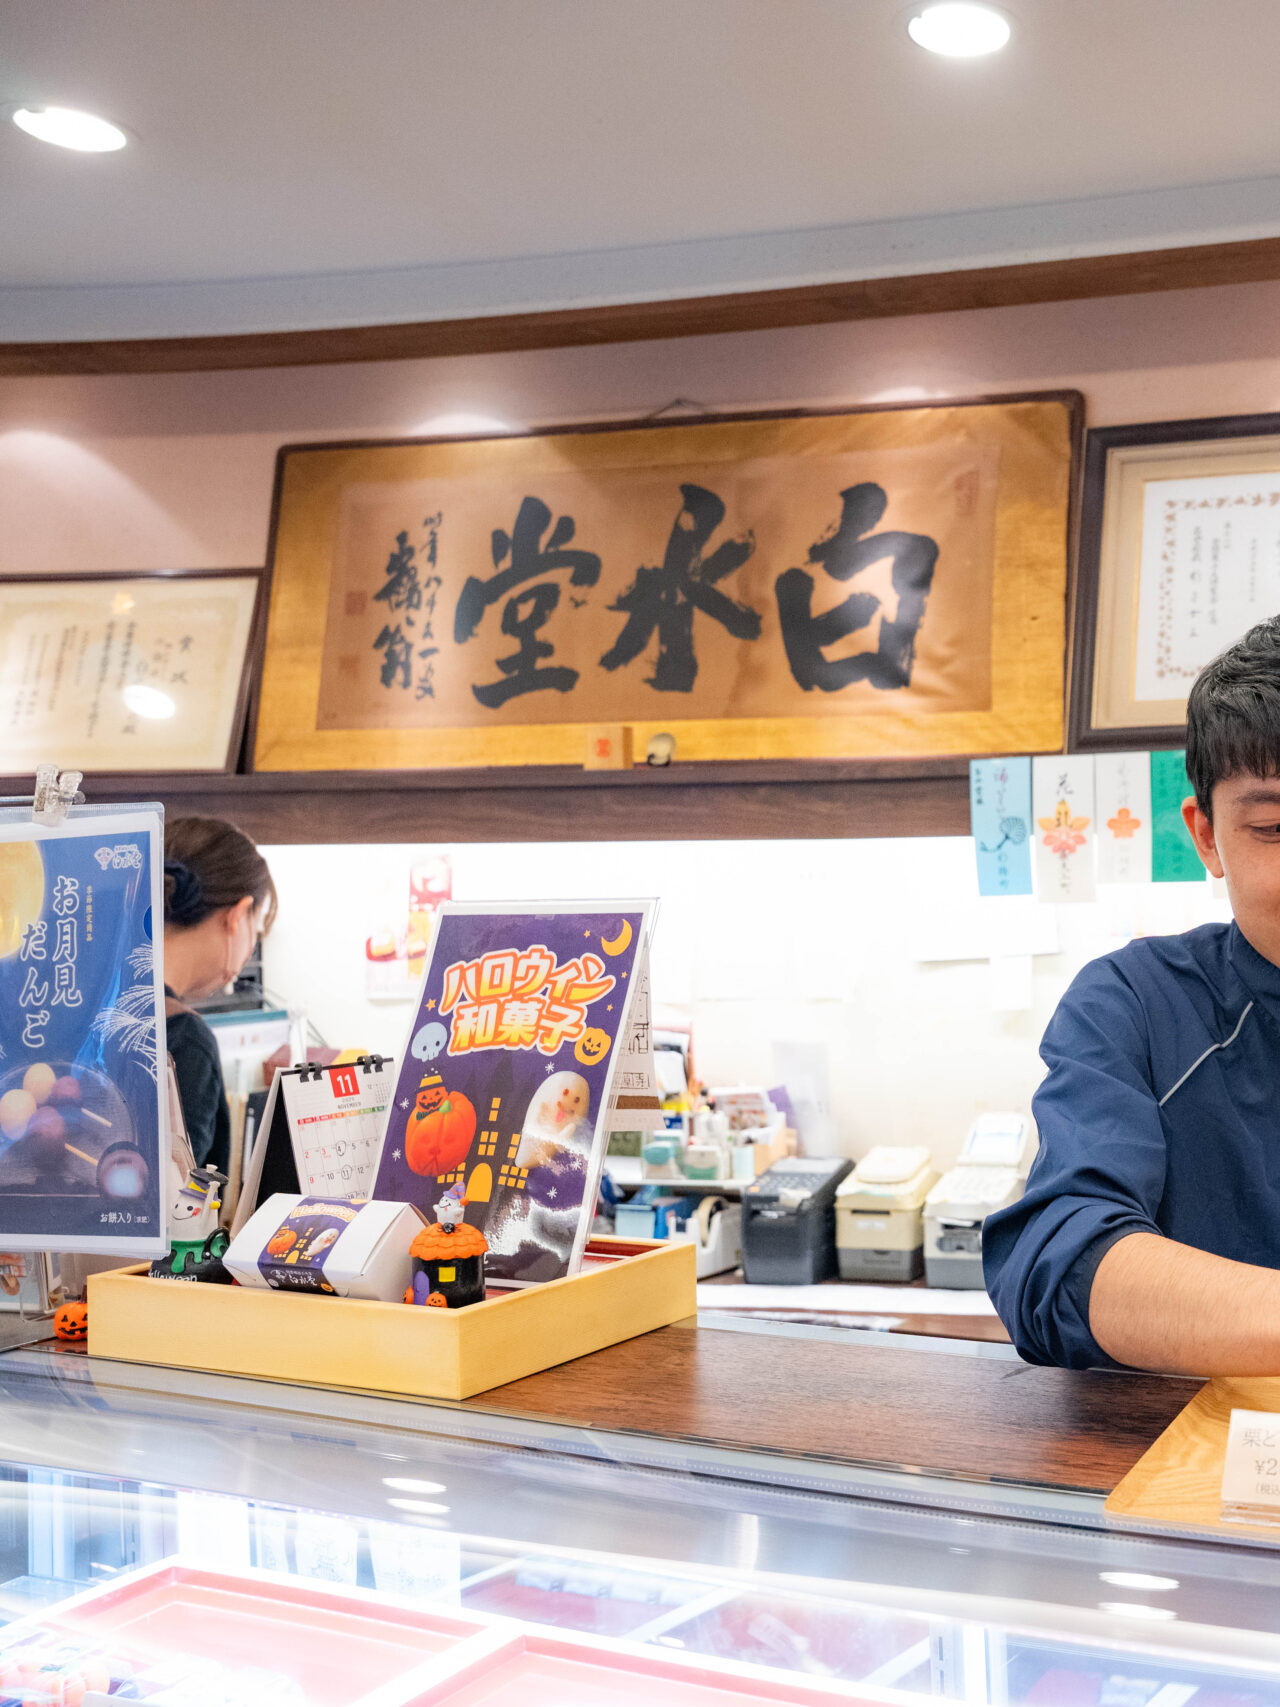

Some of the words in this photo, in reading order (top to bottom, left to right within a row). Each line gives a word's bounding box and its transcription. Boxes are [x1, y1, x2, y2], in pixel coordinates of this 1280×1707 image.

[51, 875, 82, 1008] お月見
[19, 921, 50, 1048] だんご
[438, 945, 616, 1015] ハロウィン
[447, 998, 588, 1057] 和菓子
[336, 1073, 354, 1095] 11
